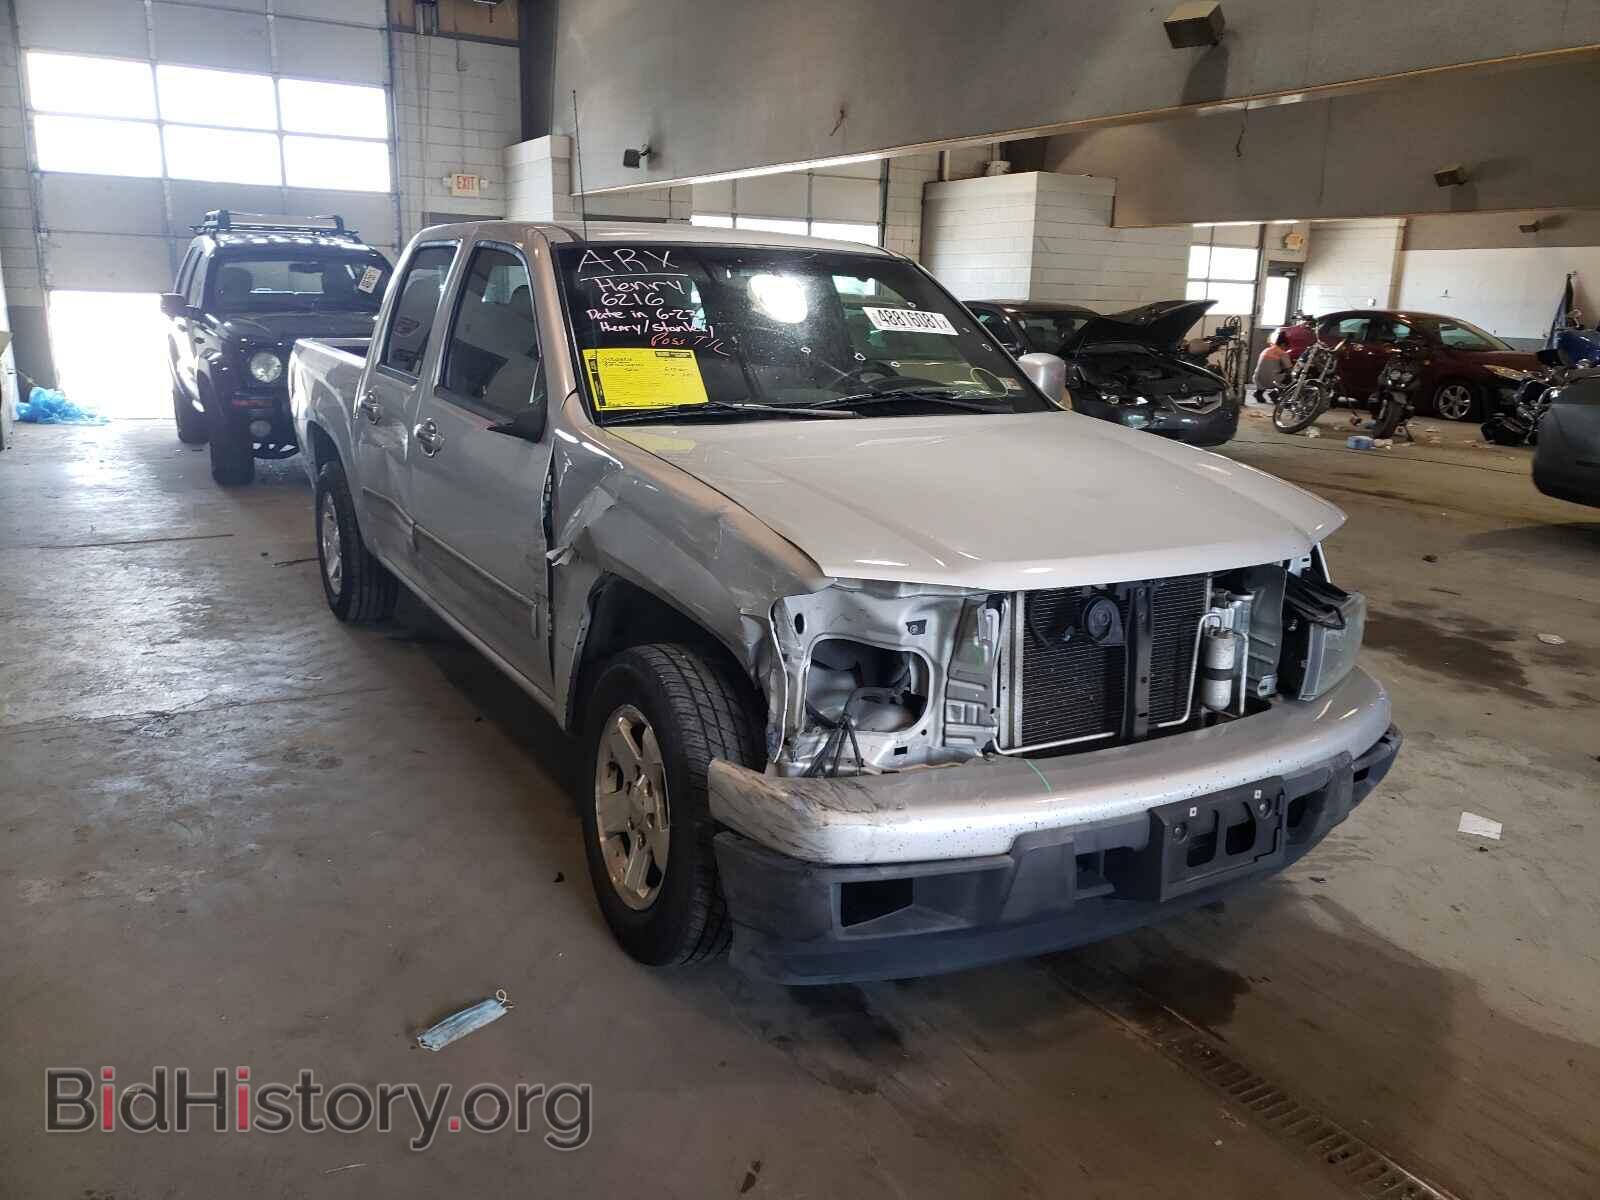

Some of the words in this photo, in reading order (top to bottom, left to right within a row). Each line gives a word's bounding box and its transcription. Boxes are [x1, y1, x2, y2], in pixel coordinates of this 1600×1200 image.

[456, 175, 474, 190] EXIT
[594, 278, 687, 295] Henry
[600, 292, 665, 306] 6216
[586, 308, 626, 320] Date
[630, 309, 649, 318] in
